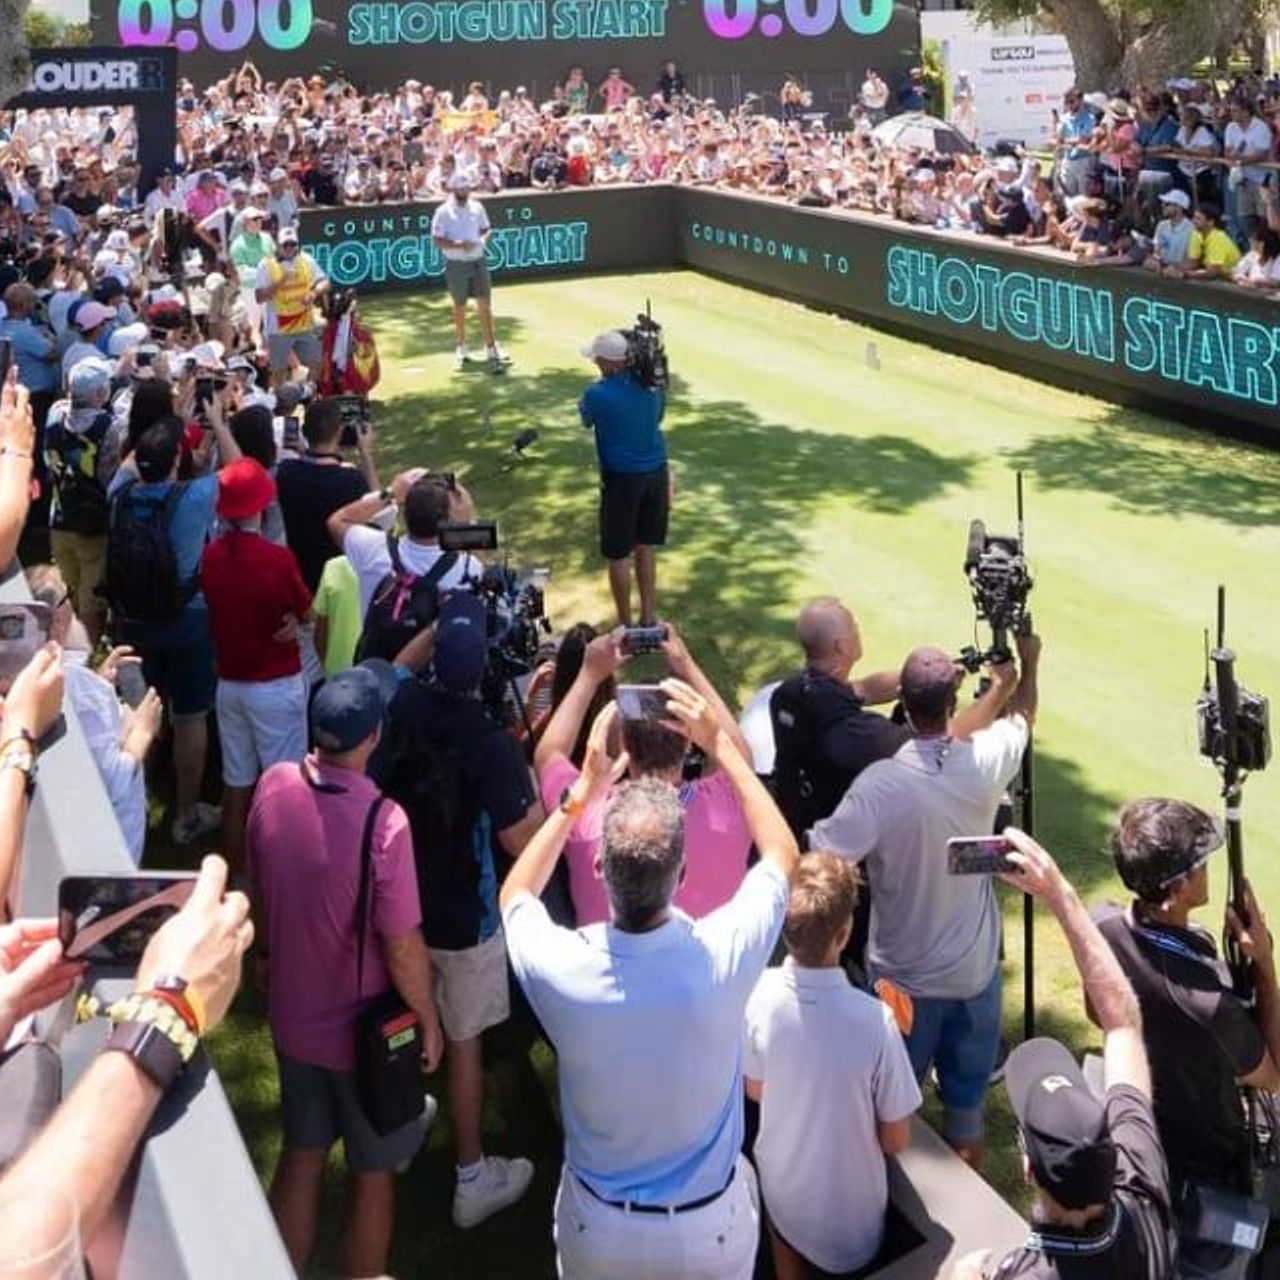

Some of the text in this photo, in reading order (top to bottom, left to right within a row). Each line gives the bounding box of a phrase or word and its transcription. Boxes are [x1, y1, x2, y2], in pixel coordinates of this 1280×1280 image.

[348, 0, 546, 45] SHOTGUN
[324, 207, 531, 236] COUNTD TO
[484, 222, 587, 271] START
[692, 223, 849, 273] COUNTDOWN TO
[887, 246, 1115, 363] SHOTGUN
